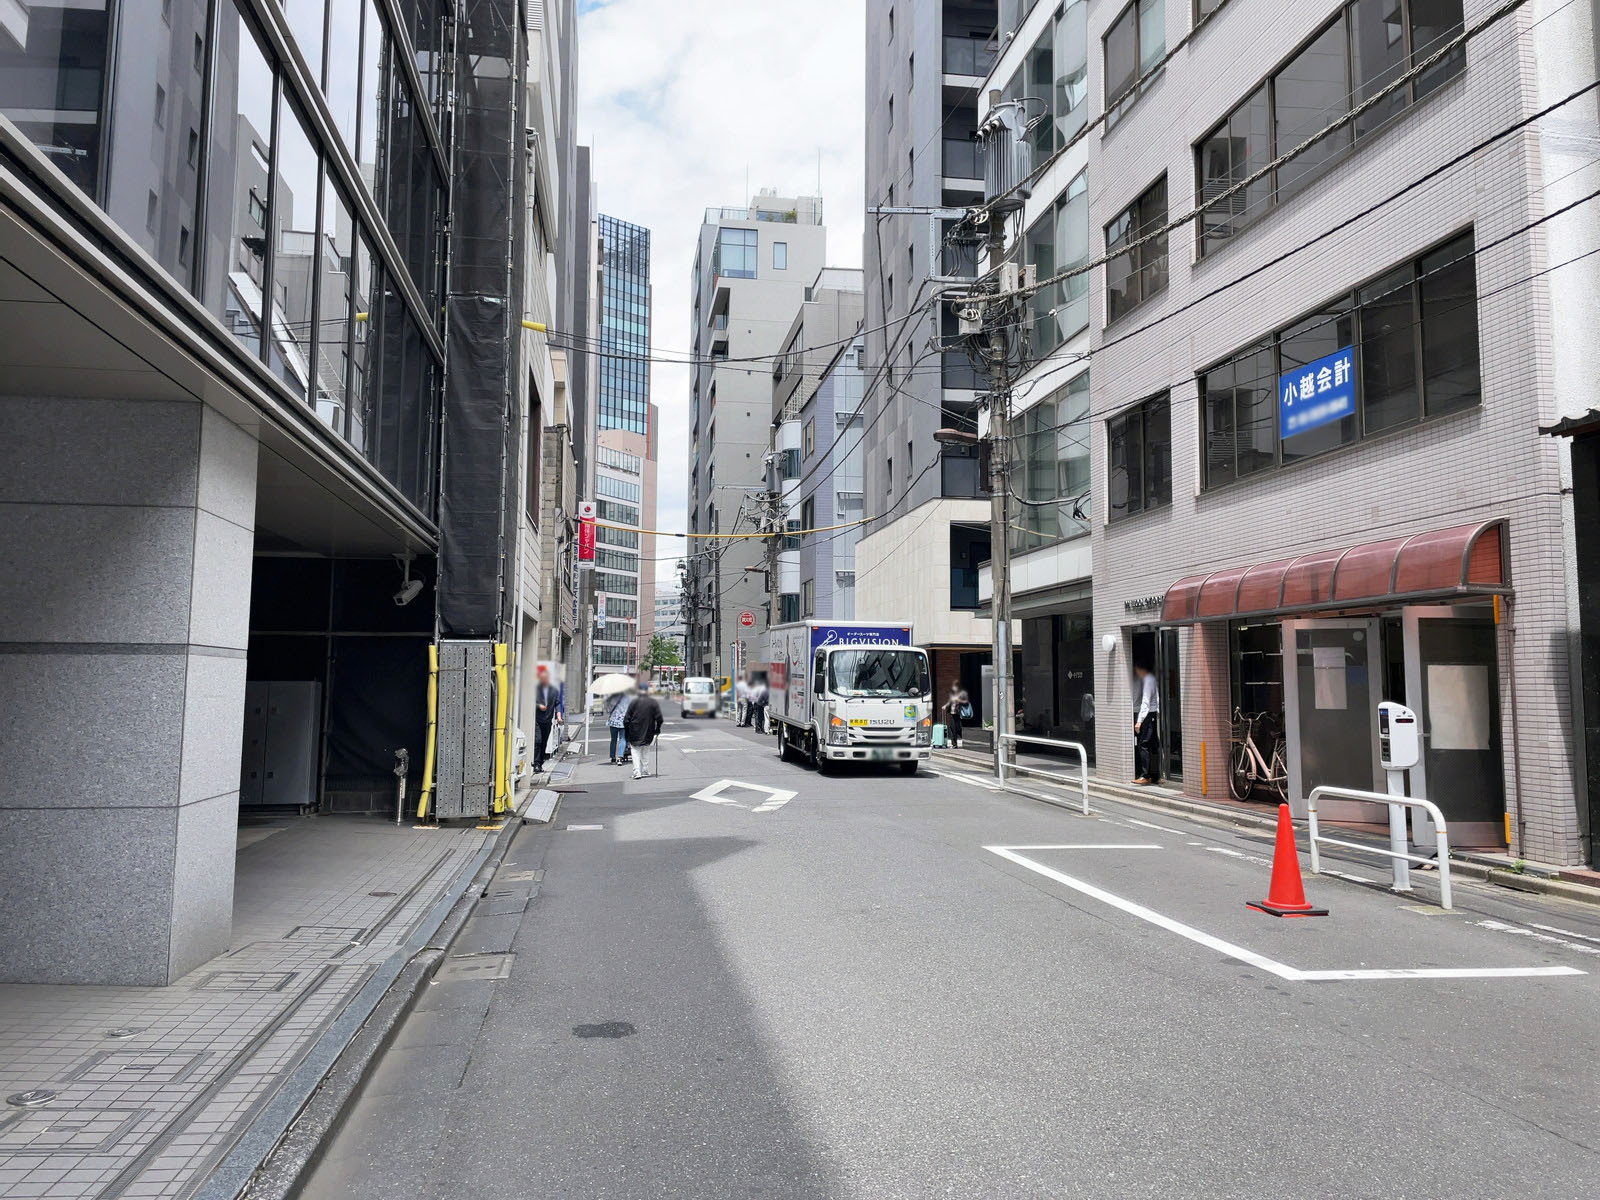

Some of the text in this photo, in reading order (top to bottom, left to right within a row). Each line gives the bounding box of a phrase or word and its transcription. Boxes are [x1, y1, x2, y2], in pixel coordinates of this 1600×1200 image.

[1283, 356, 1351, 407] 小越会計
[839, 637, 899, 646] BIGVISION
